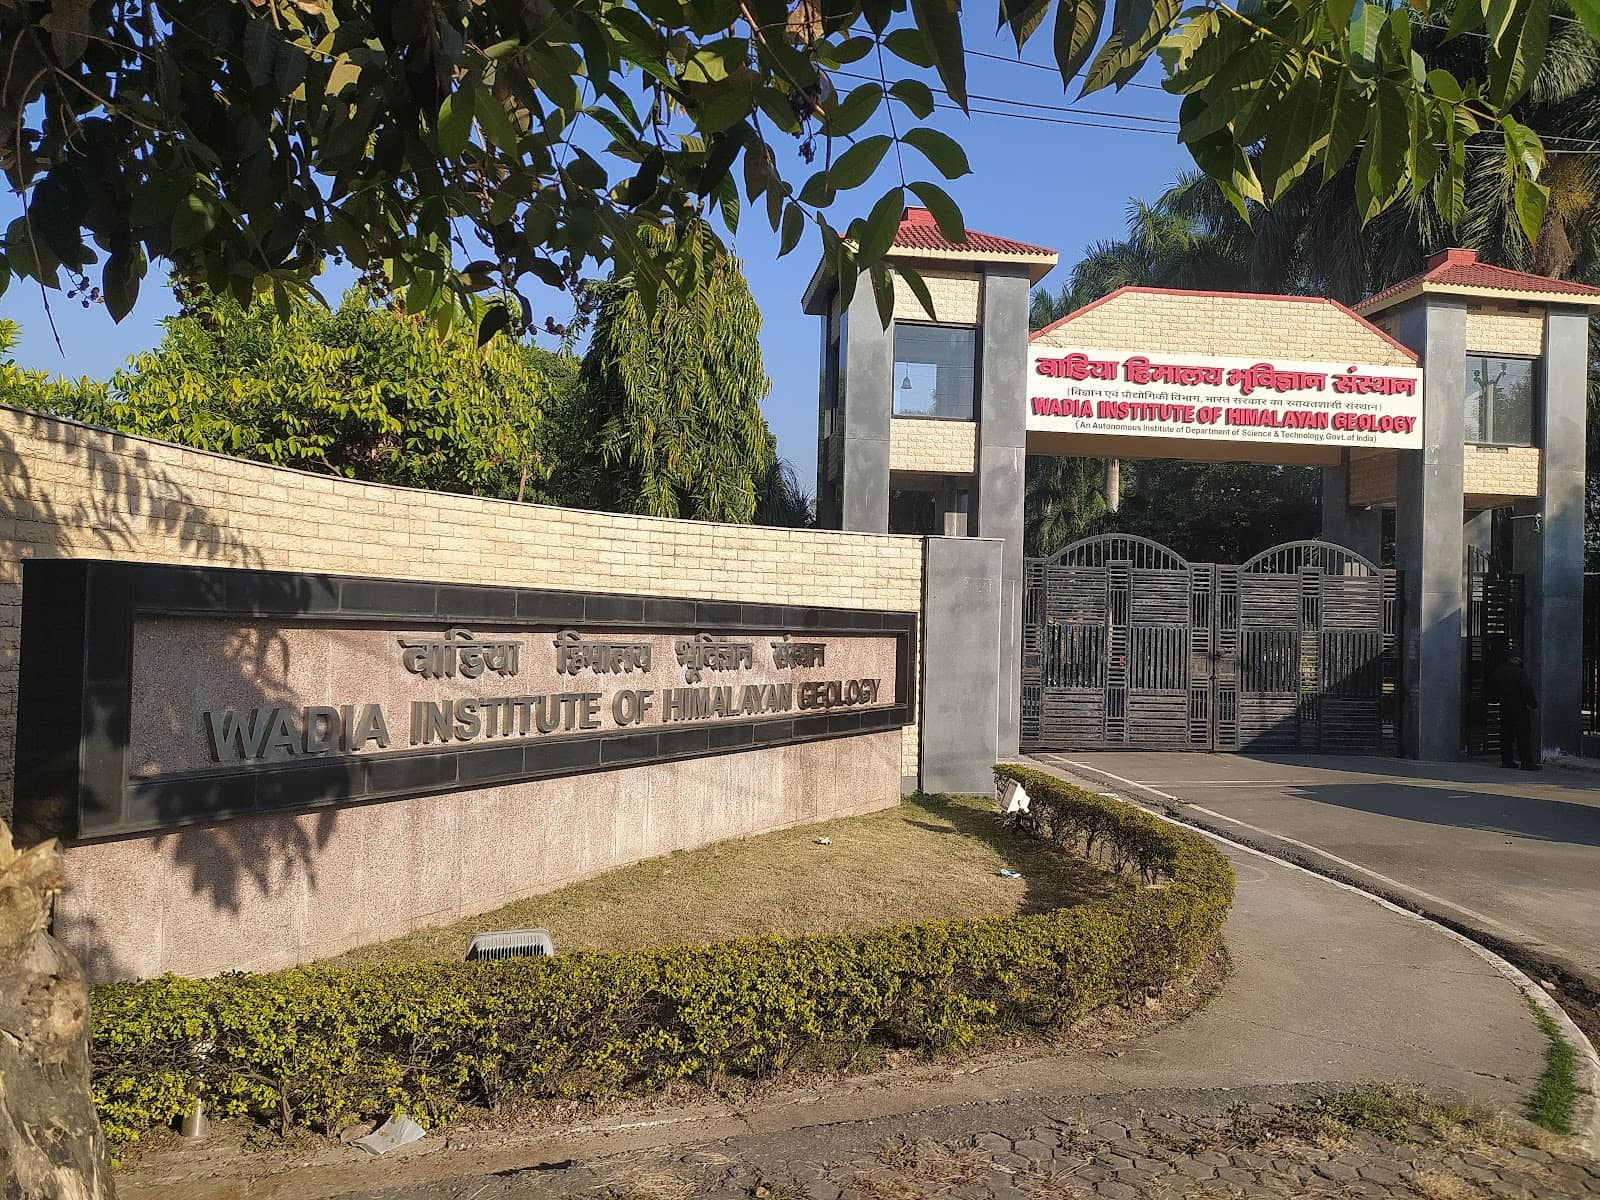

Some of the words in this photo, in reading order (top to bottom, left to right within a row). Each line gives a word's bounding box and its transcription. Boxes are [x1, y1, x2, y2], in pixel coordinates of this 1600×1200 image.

[1035, 353, 1119, 381] वाडिया
[1122, 356, 1225, 386] हिमालय
[1226, 363, 1328, 396] भूविज्ञान
[1331, 366, 1417, 397] संस्थान
[1031, 397, 1094, 418] WADIA
[1097, 400, 1195, 423] INSTITUTE
[1196, 405, 1222, 425] OF
[1225, 407, 1329, 430] HIMALAYAN
[1331, 412, 1416, 434] GEOLOGY
[1205, 396, 1230, 404] भारत
[1232, 397, 1267, 406] सरकार
[1075, 420, 1091, 430] (An
[1092, 421, 1142, 431] Autonomous
[1143, 424, 1175, 433] Institute
[1185, 427, 1230, 436] Department
[1231, 428, 1240, 436] of
[1242, 429, 1272, 438] Science
[1356, 434, 1377, 443] India)
[397, 629, 523, 680] वाडिया
[553, 630, 651, 676] हिमालय
[674, 632, 753, 685] भूविज्ञान
[770, 634, 827, 671] संस्थान
[203, 703, 391, 762] WADIA
[409, 692, 602, 746] INSTITUTE
[611, 689, 654, 727] OF
[662, 682, 793, 723] HIMALAYAN
[796, 678, 881, 711] GEOLOGY
